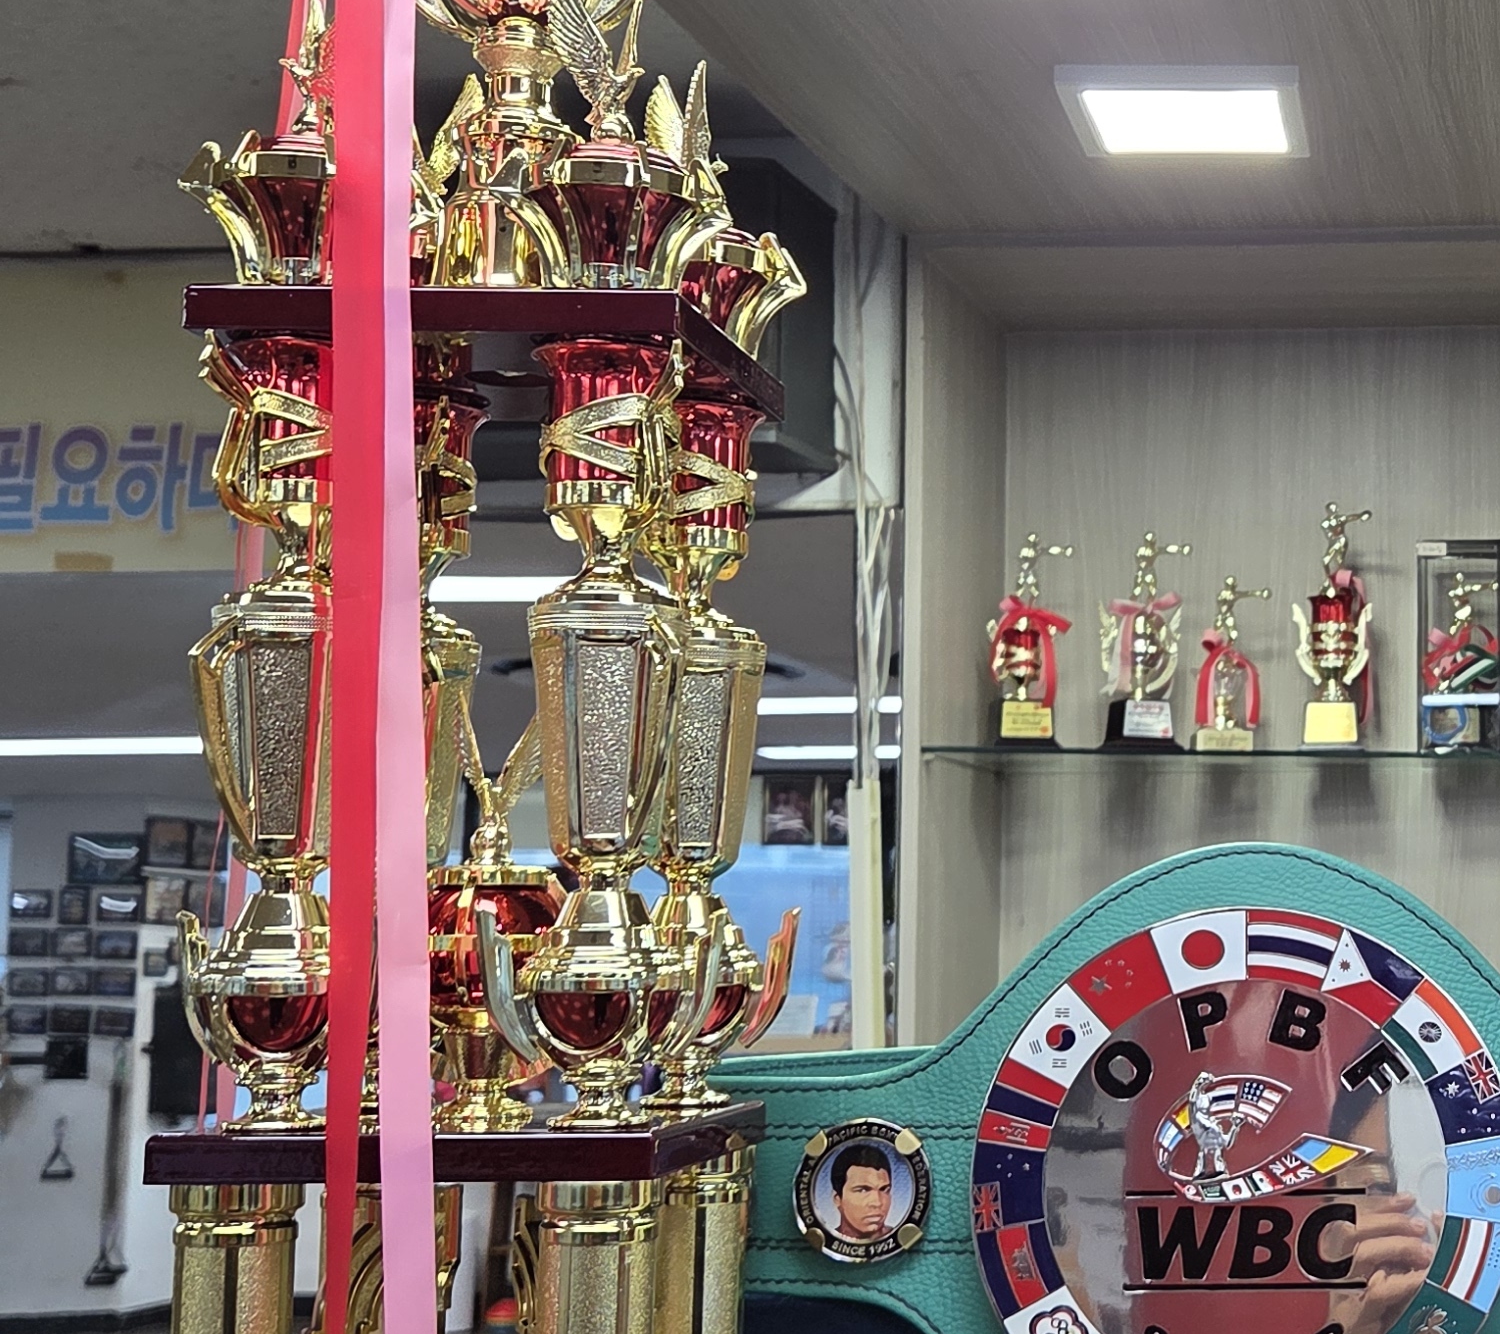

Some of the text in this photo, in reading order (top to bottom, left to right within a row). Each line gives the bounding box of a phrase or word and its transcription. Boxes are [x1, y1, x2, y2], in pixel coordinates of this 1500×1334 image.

[1091, 988, 1411, 1102] OPBF
[911, 1153, 927, 1221] EDERATION
[831, 1240, 866, 1256] SINCE
[1136, 1202, 1359, 1282] WBC
